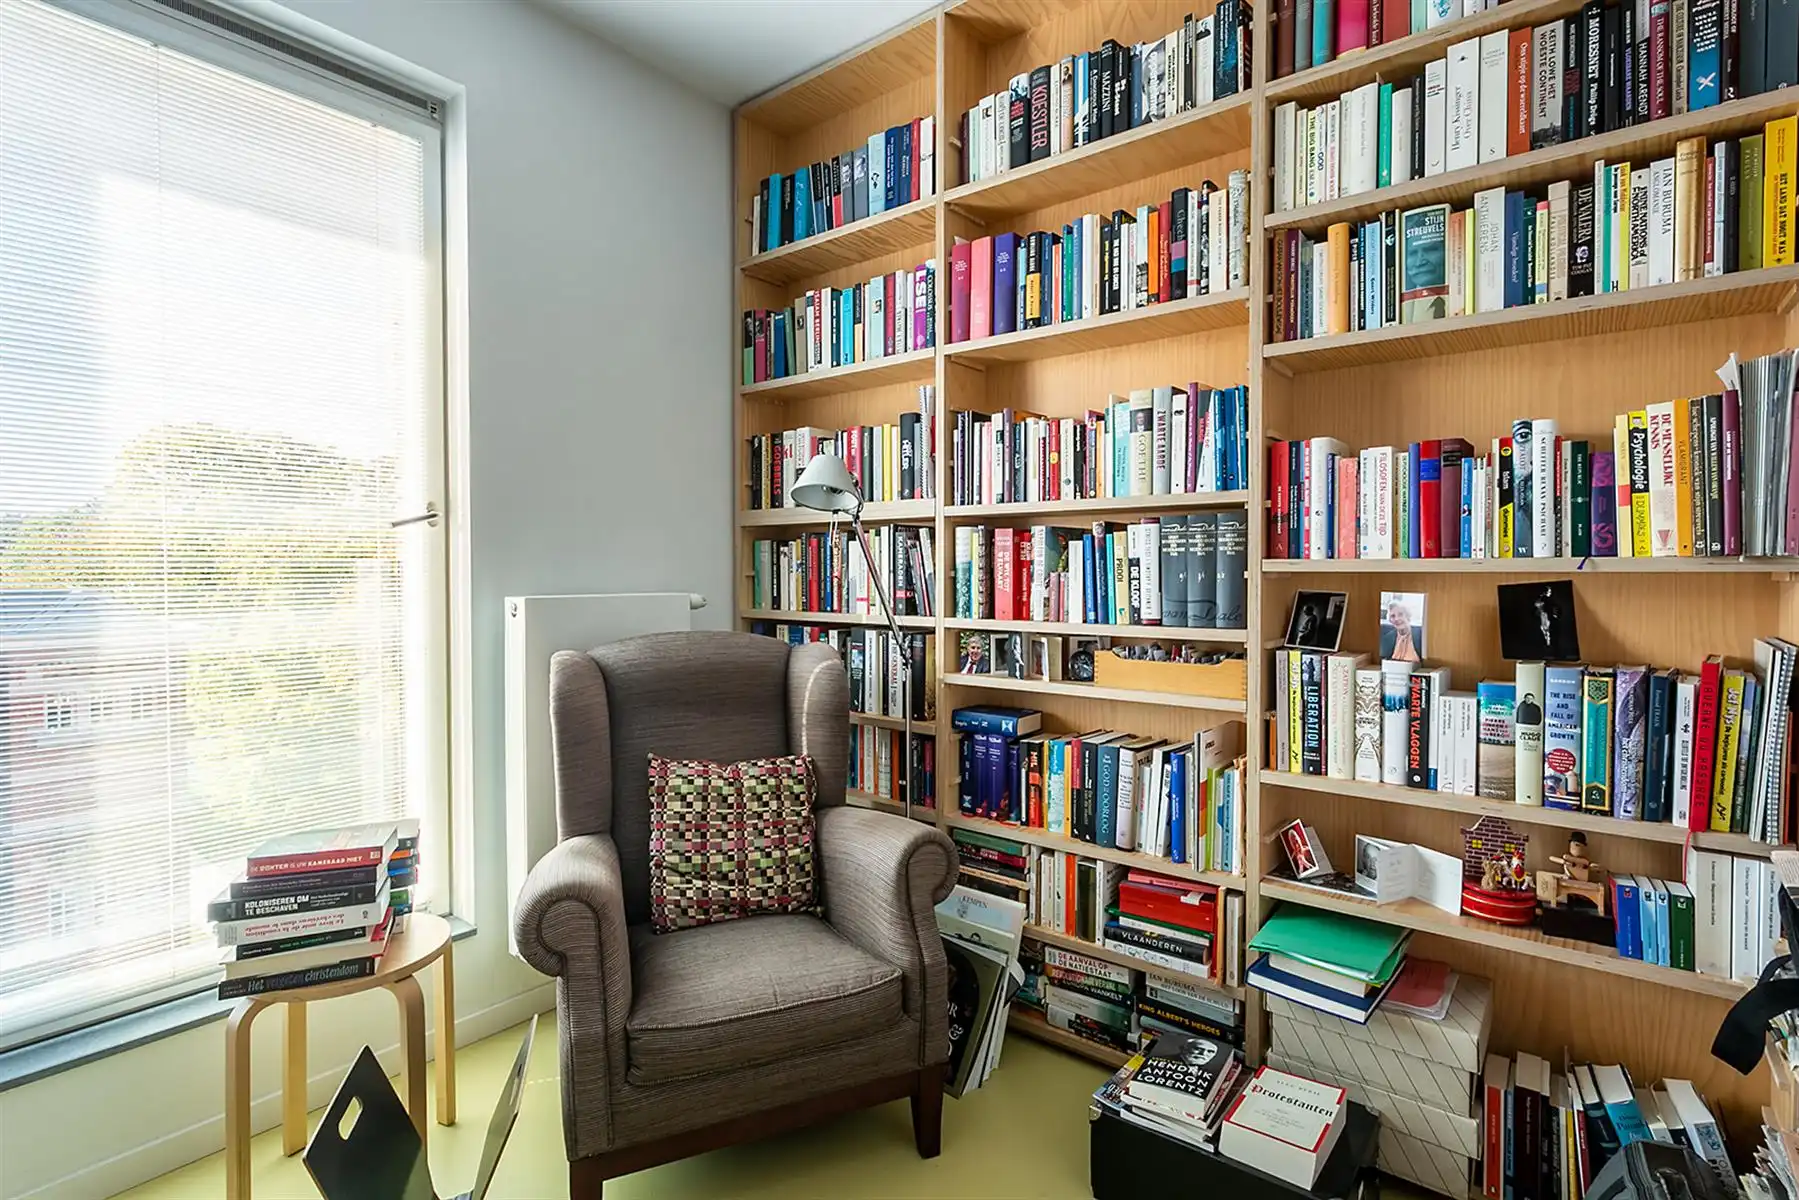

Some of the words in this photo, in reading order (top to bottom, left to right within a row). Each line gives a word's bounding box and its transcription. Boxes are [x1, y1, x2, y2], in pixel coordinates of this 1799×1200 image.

[1548, 28, 1556, 54] KEITH
[1588, 17, 1600, 79] MORESNET
[1548, 56, 1556, 81] LOWE
[1638, 42, 1648, 81] HANNAH
[1102, 70, 1111, 112] MAZZINI
[1538, 70, 1546, 118] CONTINENT
[1548, 83, 1556, 100] HET
[1588, 82, 1598, 104] Philip
[1638, 83, 1648, 117] ARENDT
[1031, 84, 1048, 150] KOESTLER
[1450, 125, 1463, 152] Henry
[1662, 167, 1672, 188] IAN
[1578, 187, 1592, 202] DE
[1631, 192, 1639, 224] NORTH
[1778, 186, 1788, 204] LAND
[1479, 196, 1488, 255] ANTHIERENS
[1578, 204, 1592, 243] VALERA
[1662, 190, 1672, 235] BURUMA
[1490, 223, 1498, 252] JOHAN
[1631, 224, 1639, 260] AMERICA
[1640, 213, 1648, 248] NATIONS
[1778, 240, 1786, 255] WAS
[1156, 410, 1167, 441] ZWARTE
[1650, 414, 1661, 449] KENNIS
[1661, 413, 1672, 426] DE
[1710, 416, 1718, 441] APOLOGIE
[773, 445, 782, 495] GOEBBELS
[1138, 434, 1147, 482] GOETHE
[1156, 444, 1167, 470] AARDE
[1630, 432, 1647, 490] Psychologie
[1662, 428, 1674, 486] MENSELIJKE
[1378, 452, 1388, 492] FILOSOFEN
[1502, 471, 1511, 490] Islam
[1378, 522, 1387, 536] TIJD
[1502, 508, 1510, 538] dummies
[1131, 566, 1140, 579] DE
[1131, 580, 1140, 608] KLOOF
[891, 656, 899, 684] GENERAL
[1410, 677, 1421, 718] ZWARTE
[1306, 686, 1318, 748] LIBERATION
[1410, 720, 1420, 768] VLAGGEN
[1720, 734, 1731, 762] beginjaren
[1102, 764, 1111, 786] GOD
[1719, 770, 1728, 796] cartoonist
[1101, 793, 1110, 834] OORLOG
[260, 862, 288, 872] DOKTER
[307, 857, 345, 866] KAMERAAD
[244, 895, 295, 909] KOLONISEREN
[256, 904, 298, 914] BESCHAVEN
[1122, 932, 1183, 954] VLAANDEREN
[1058, 952, 1066, 960] DE
[1069, 954, 1098, 967] AANVAL
[1069, 963, 1112, 978] NATIESTAAT
[247, 980, 264, 992] Het
[305, 964, 359, 982] christendom
[1091, 988, 1122, 1001] WANKELT
[1139, 1004, 1155, 1014] KING
[1156, 1010, 1190, 1026] ALBERT'S
[1192, 1020, 1220, 1036] HEROES
[1142, 1067, 1208, 1088] ANTOON
[1148, 1060, 1212, 1080] HENDRIK
[1137, 1074, 1204, 1096] LORENTZ
[1250, 1083, 1334, 1118] Protestanten
